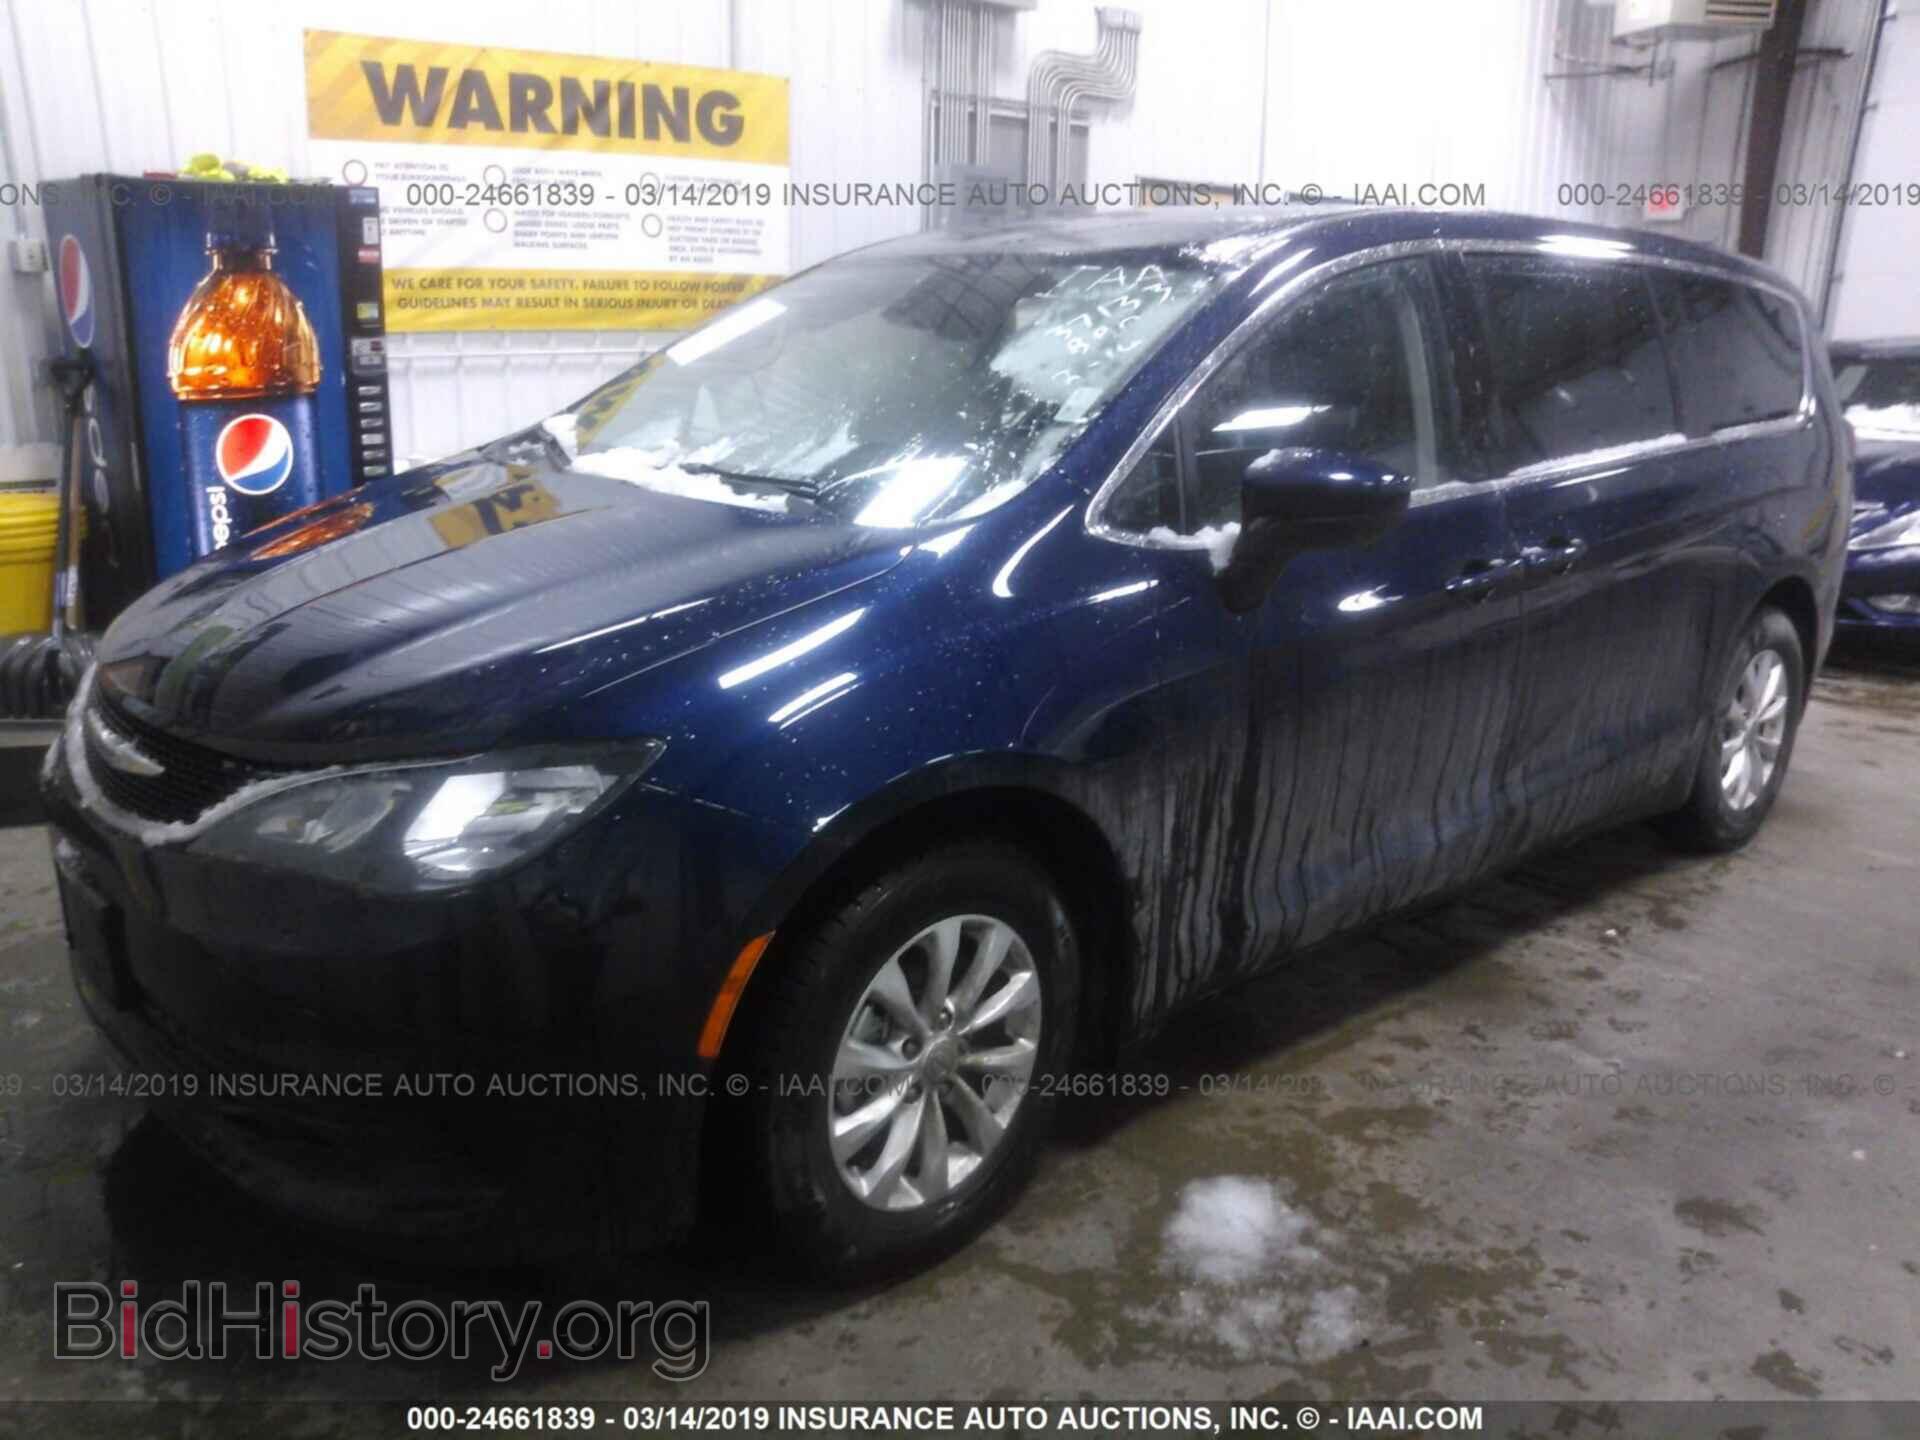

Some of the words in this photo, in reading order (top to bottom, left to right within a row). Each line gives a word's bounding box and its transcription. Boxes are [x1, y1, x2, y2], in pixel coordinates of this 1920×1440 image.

[362, 60, 745, 147] WARNING
[391, 277, 414, 289] WE
[419, 277, 451, 289] CARE
[456, 277, 483, 289] FOR
[488, 277, 523, 289] YOUR
[583, 279, 629, 291] FAILURE
[634, 279, 648, 291] TO
[653, 279, 699, 292] FOLLOW
[397, 296, 477, 309] GUIDELINES
[481, 296, 511, 308] MAY
[516, 296, 559, 308] RESULT
[564, 296, 578, 308] IN
[583, 297, 635, 310] SERIOUS
